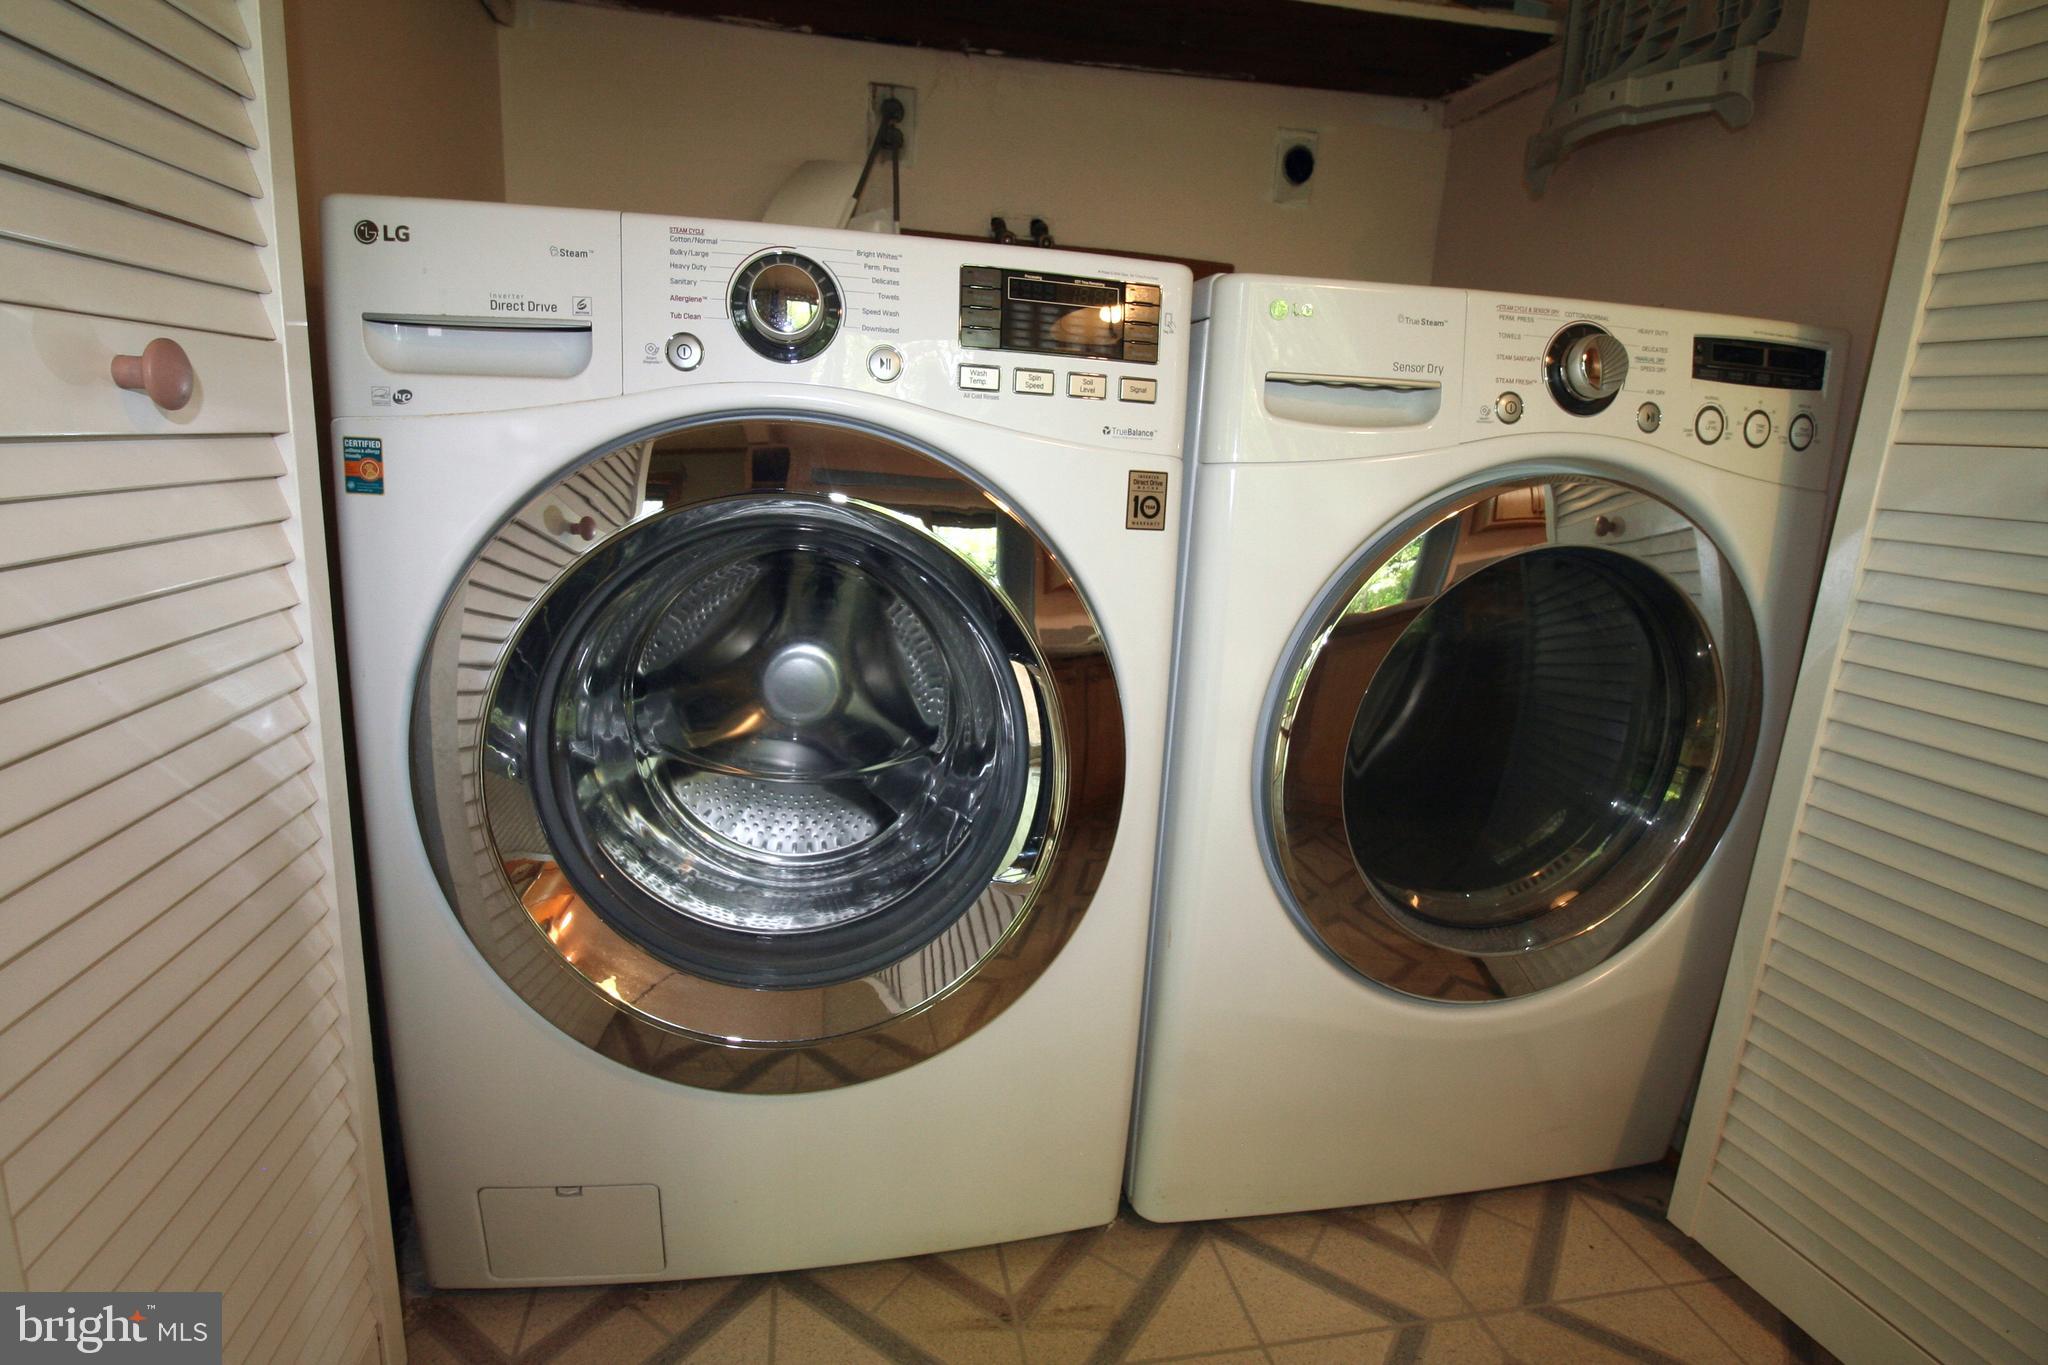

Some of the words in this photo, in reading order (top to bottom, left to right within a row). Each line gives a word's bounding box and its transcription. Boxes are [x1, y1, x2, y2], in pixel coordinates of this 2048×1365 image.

[383, 225, 410, 242] LG
[669, 227, 687, 235] STEAM
[669, 235, 718, 245] Cotton/Normal
[669, 248, 709, 258] Bulky/Large
[857, 250, 875, 258] Bright
[669, 262, 690, 271] Heavy
[691, 263, 707, 272] Duty
[882, 265, 900, 273] Press
[670, 277, 697, 287] Sanitary
[872, 277, 900, 286] Delicates
[878, 292, 900, 301] Towels
[490, 299, 525, 312] Direct
[527, 300, 558, 313] Drive
[862, 308, 881, 317] Speed
[882, 310, 900, 318] Wash
[862, 325, 900, 334] Downloaded
[970, 369, 988, 377] Wash
[1392, 361, 1425, 373] Sensor
[1427, 363, 1444, 376] Dry
[1028, 374, 1042, 382] Spin
[1082, 378, 1094, 386] Soil
[1025, 381, 1045, 390] Speed
[1080, 386, 1096, 394] Level
[1129, 385, 1148, 394] Signal
[344, 439, 381, 449] CERTIFIED
[1133, 478, 1149, 486] Direct
[1149, 479, 1163, 487] Drive
[1133, 495, 1161, 519] 10
